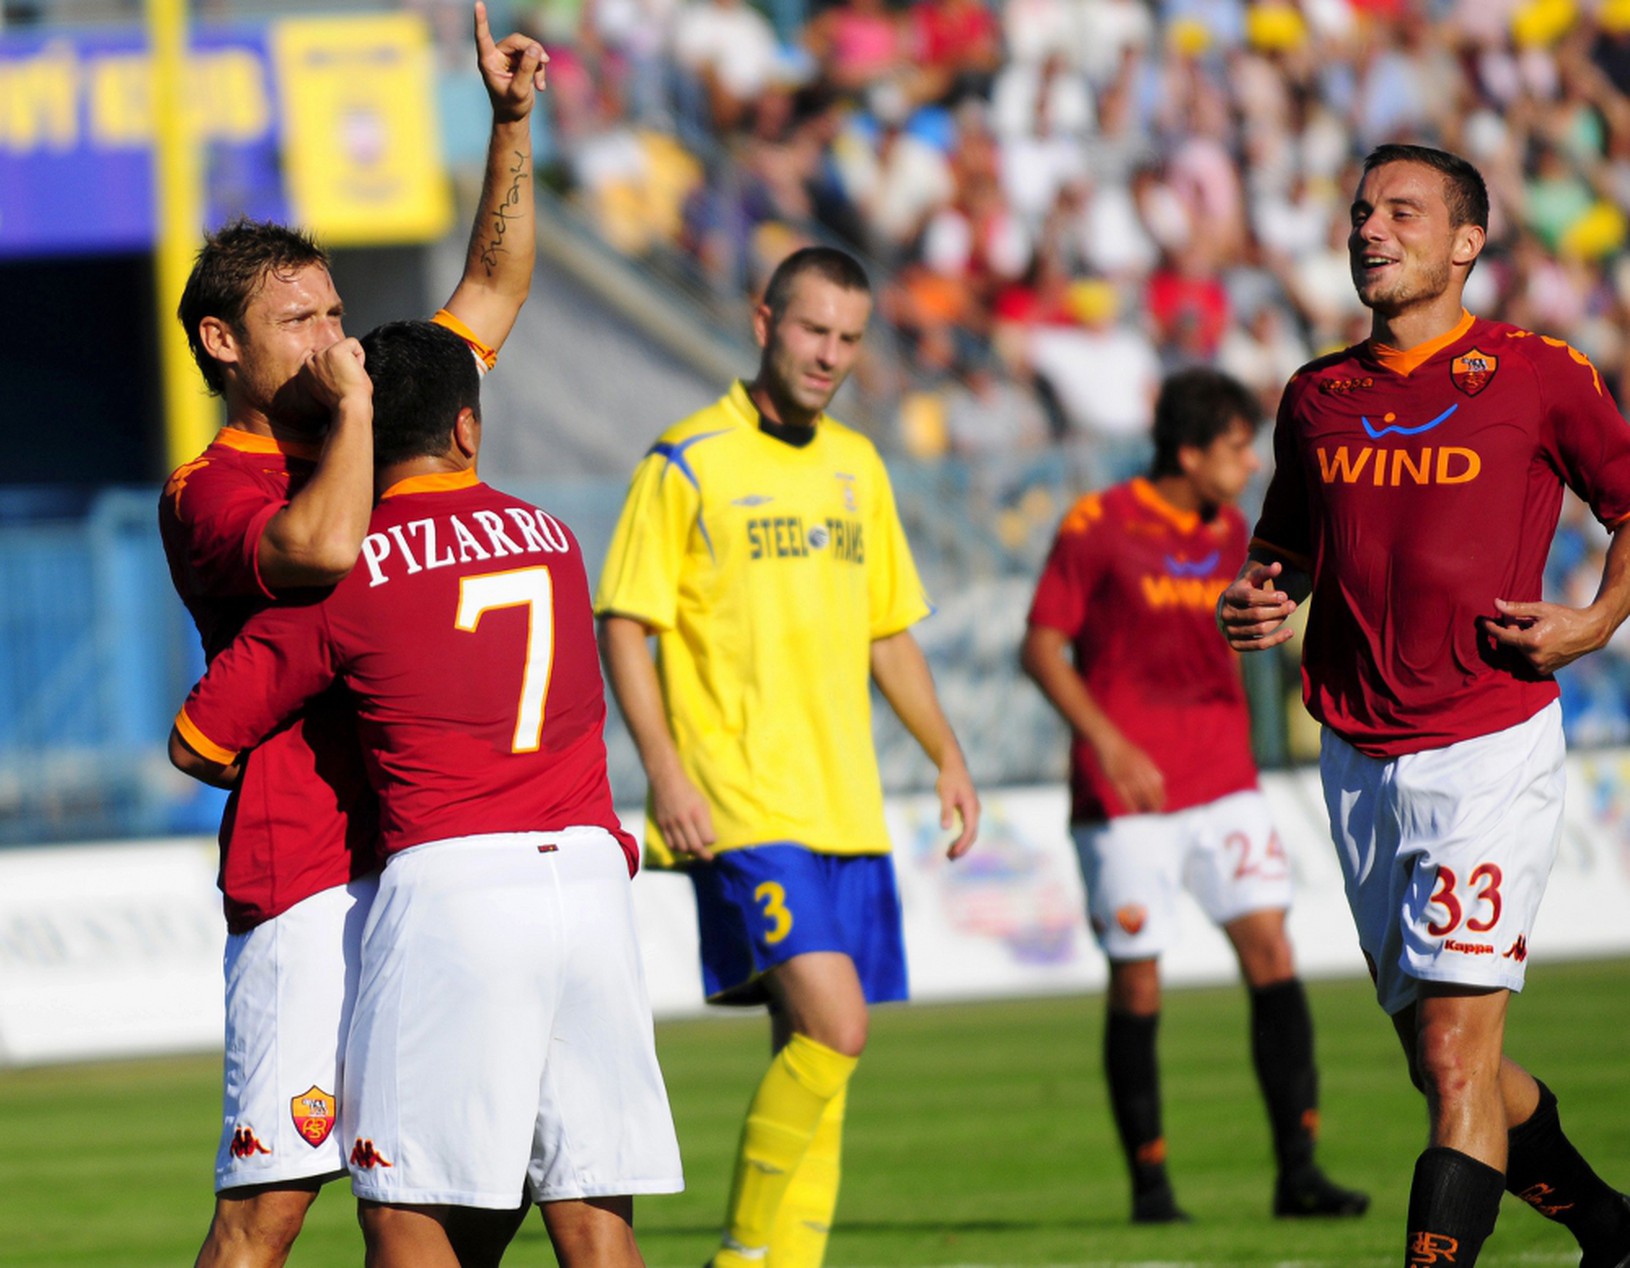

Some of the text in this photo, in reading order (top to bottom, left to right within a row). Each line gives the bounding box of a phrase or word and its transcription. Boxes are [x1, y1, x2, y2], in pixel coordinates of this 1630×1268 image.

[1316, 446, 1481, 487] WIND
[361, 507, 569, 588] PIZARRO
[747, 516, 809, 560] STEEL
[454, 565, 555, 754] 7
[754, 881, 794, 944] 3
[1427, 862, 1503, 937] 33
[1444, 939, 1495, 955] Kappa
